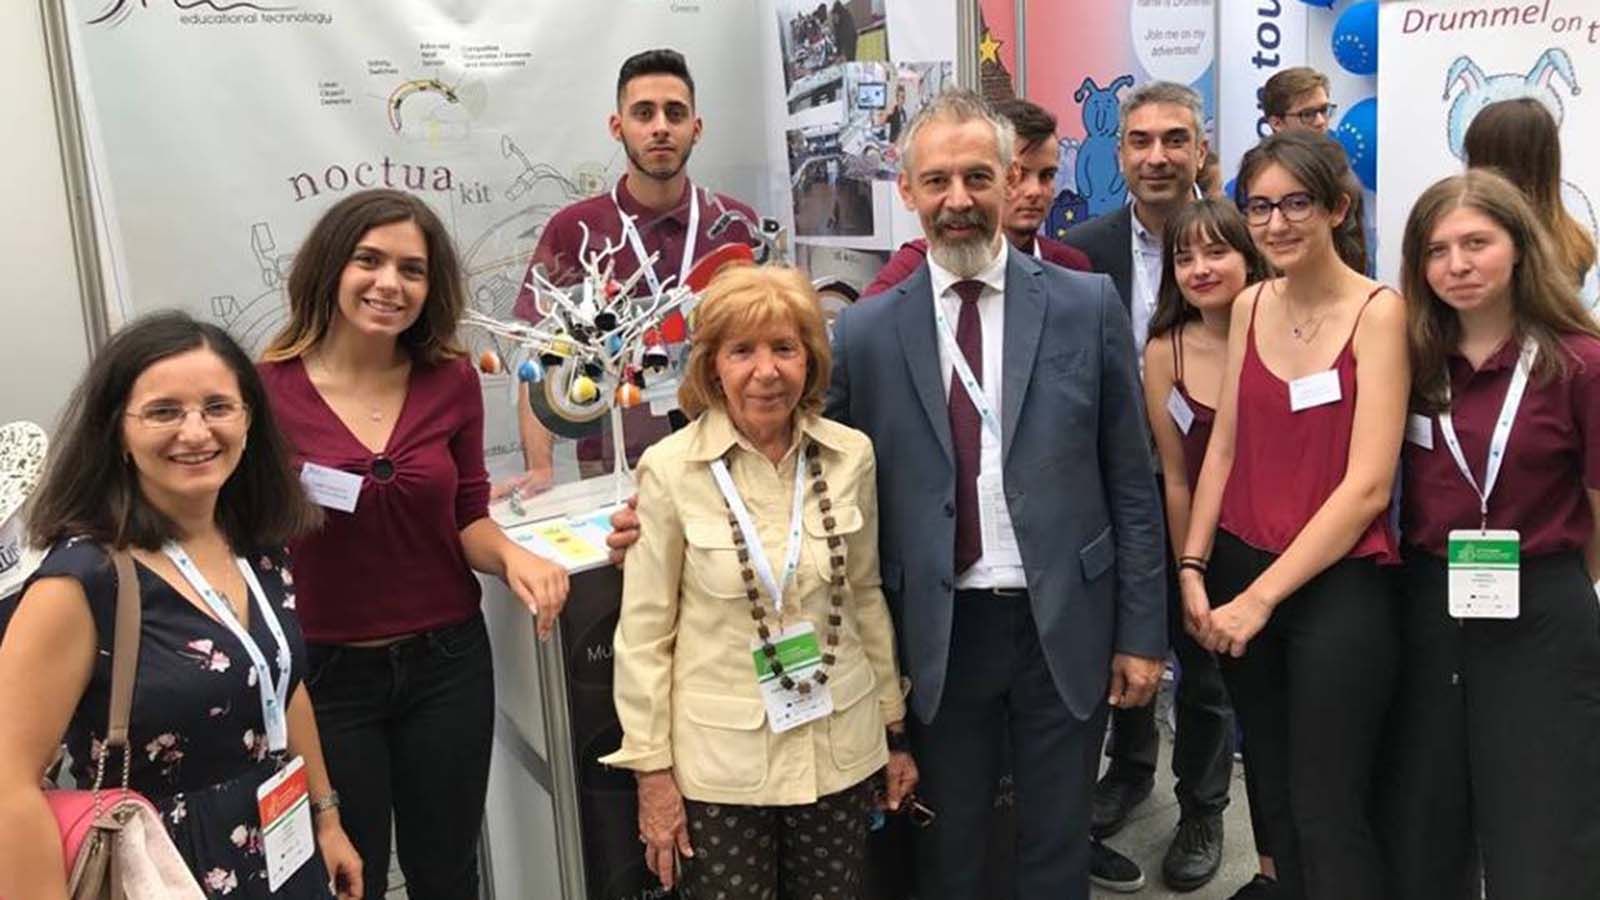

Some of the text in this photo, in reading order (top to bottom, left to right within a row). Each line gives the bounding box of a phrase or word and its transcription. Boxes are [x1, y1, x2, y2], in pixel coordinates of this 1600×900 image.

[180, 13, 333, 25] educational technology
[1402, 0, 1549, 34] Drummel
[1551, 16, 1582, 33] on
[1144, 29, 1206, 41] Join me on my
[288, 156, 491, 205] noctua kit
